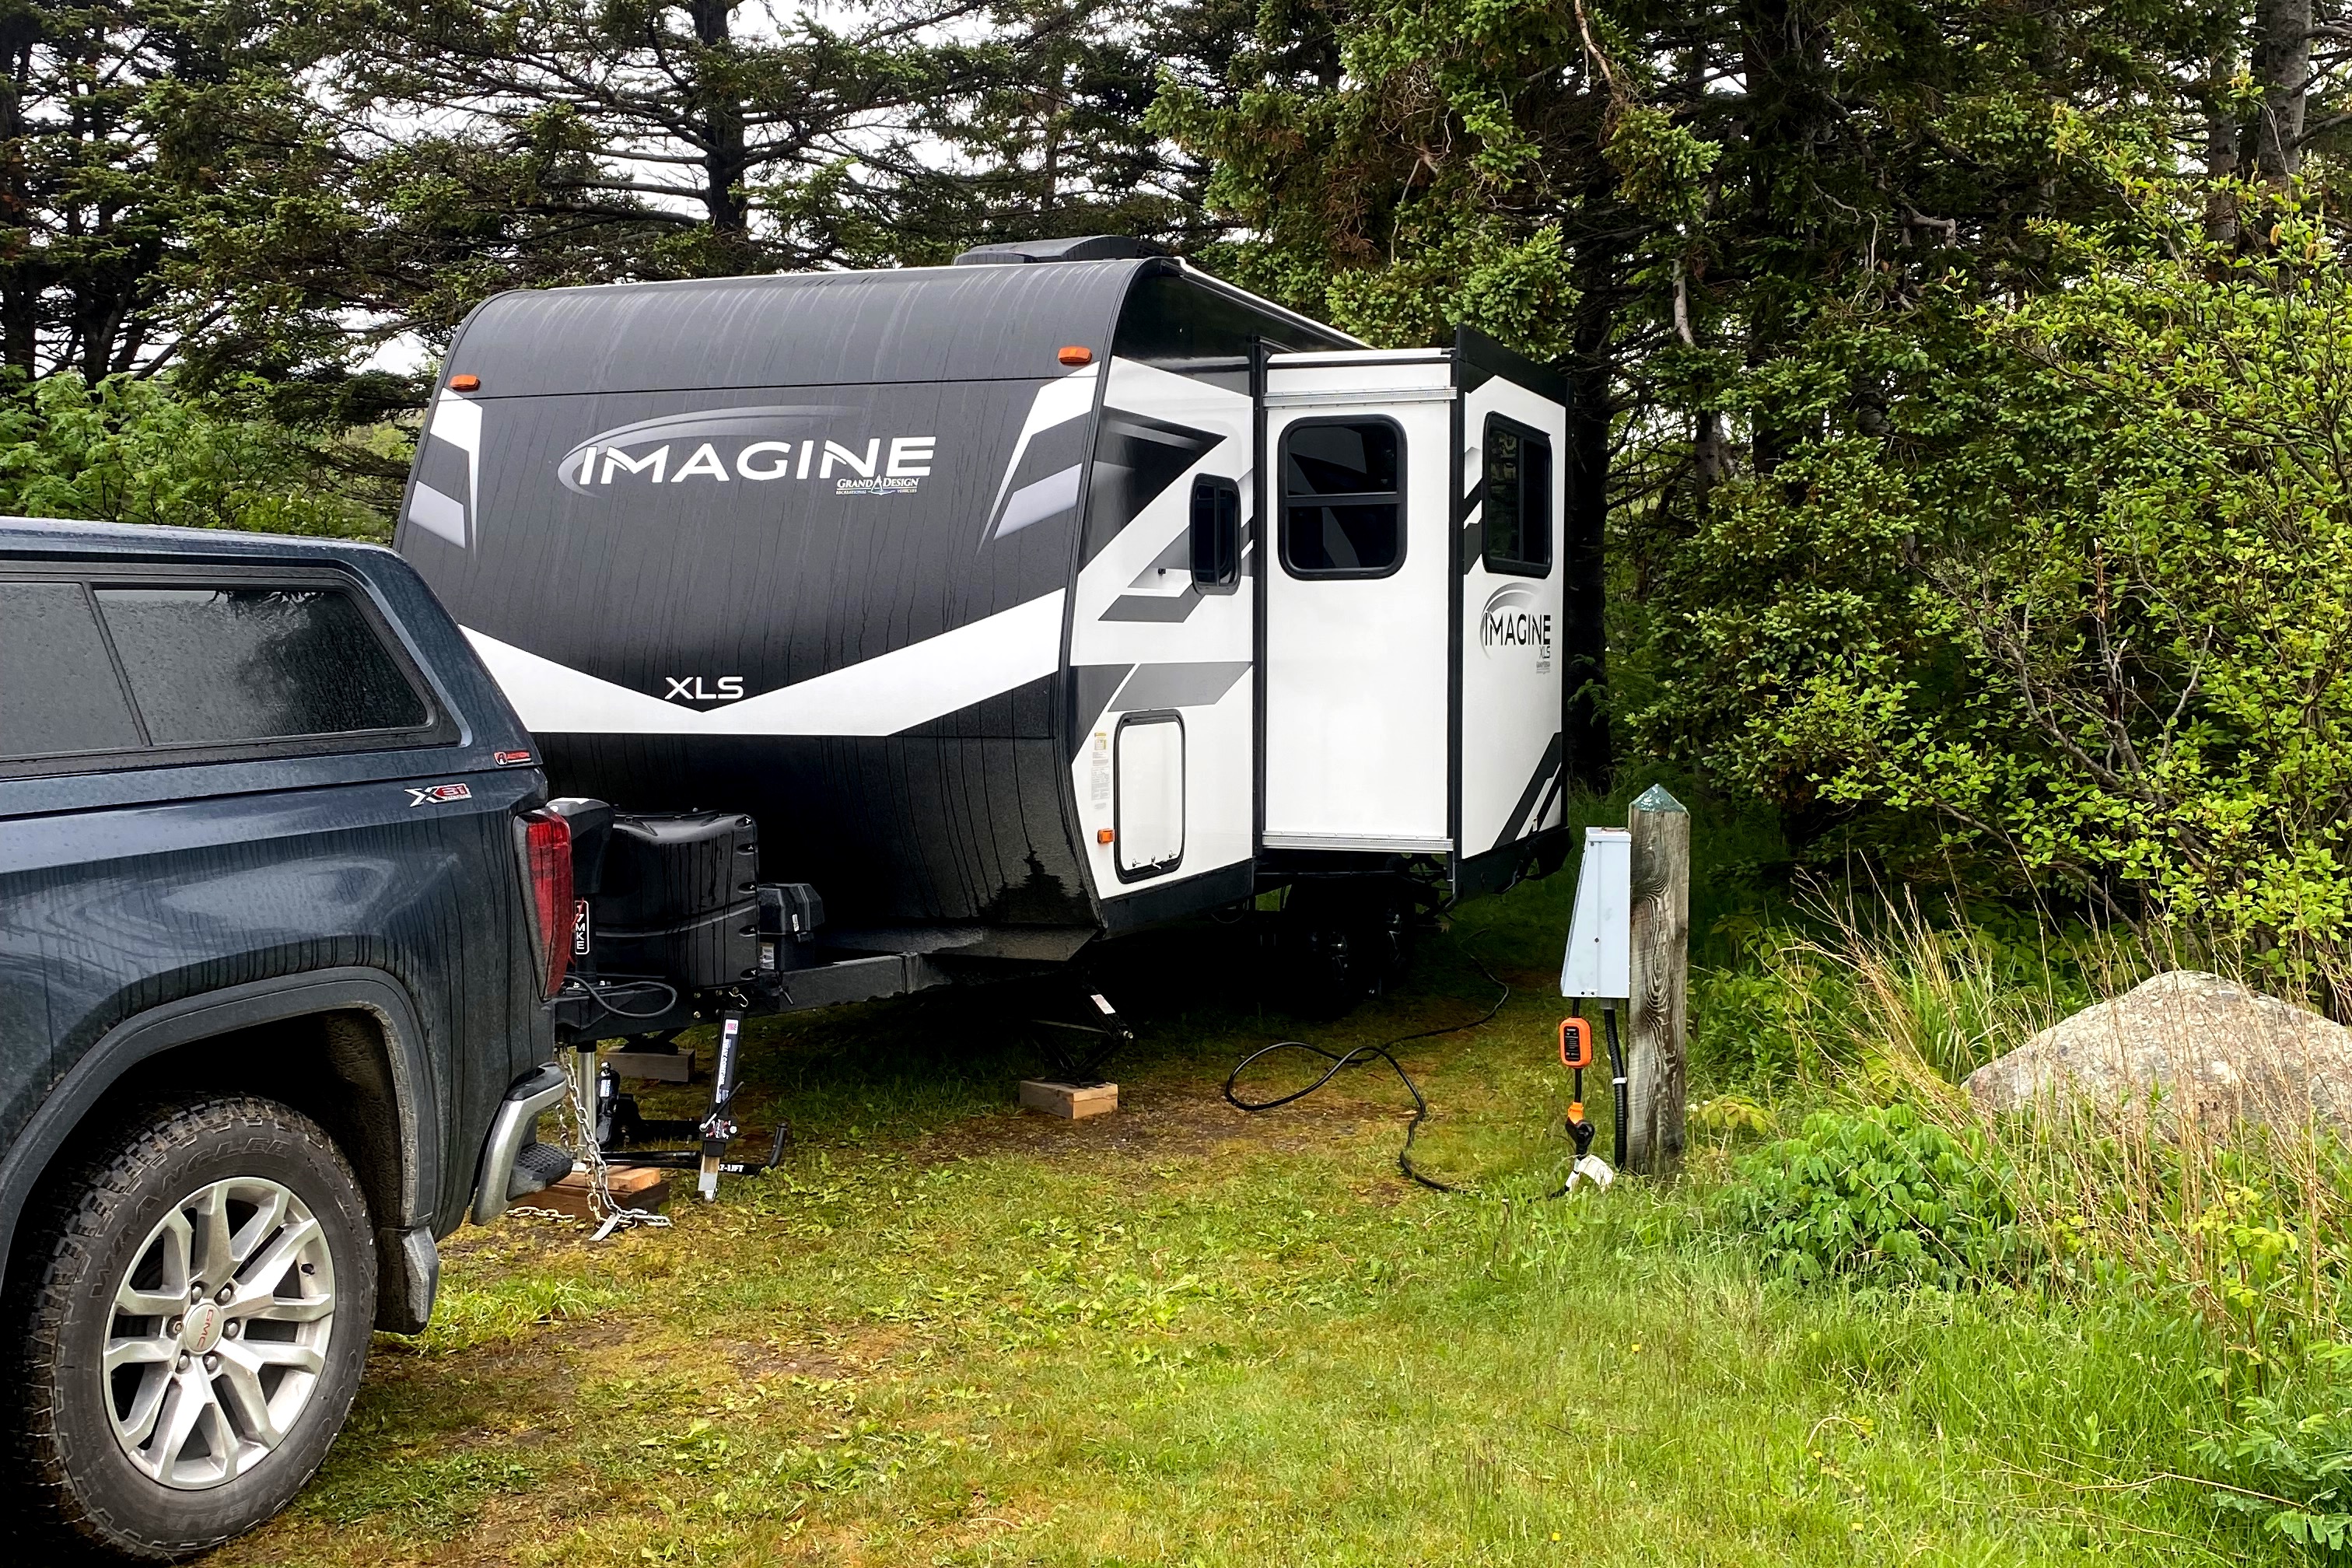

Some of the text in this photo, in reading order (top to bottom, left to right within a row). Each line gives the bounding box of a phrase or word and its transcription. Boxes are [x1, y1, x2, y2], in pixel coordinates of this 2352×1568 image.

[579, 436, 936, 485] IMAGINE
[836, 477, 920, 488] GRAND DESIGN
[1485, 612, 1550, 646] IMAGINE
[665, 677, 744, 700] XLS
[404, 782, 472, 807] X31
[196, 1309, 213, 1348] GMC
